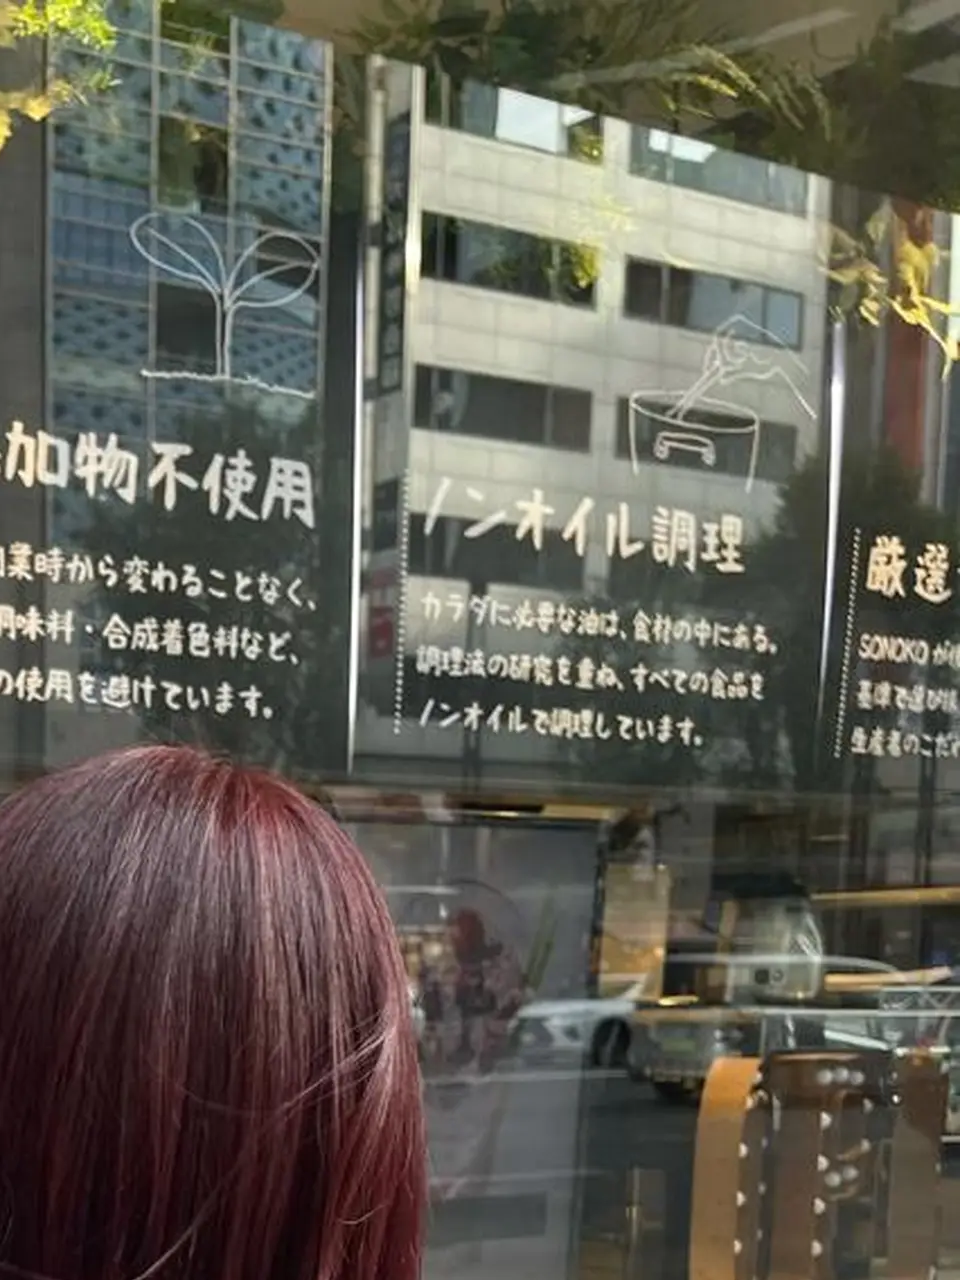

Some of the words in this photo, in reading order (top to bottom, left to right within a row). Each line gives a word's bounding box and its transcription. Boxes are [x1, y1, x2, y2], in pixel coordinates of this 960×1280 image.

[423, 478, 745, 573] ノンオイル調理
